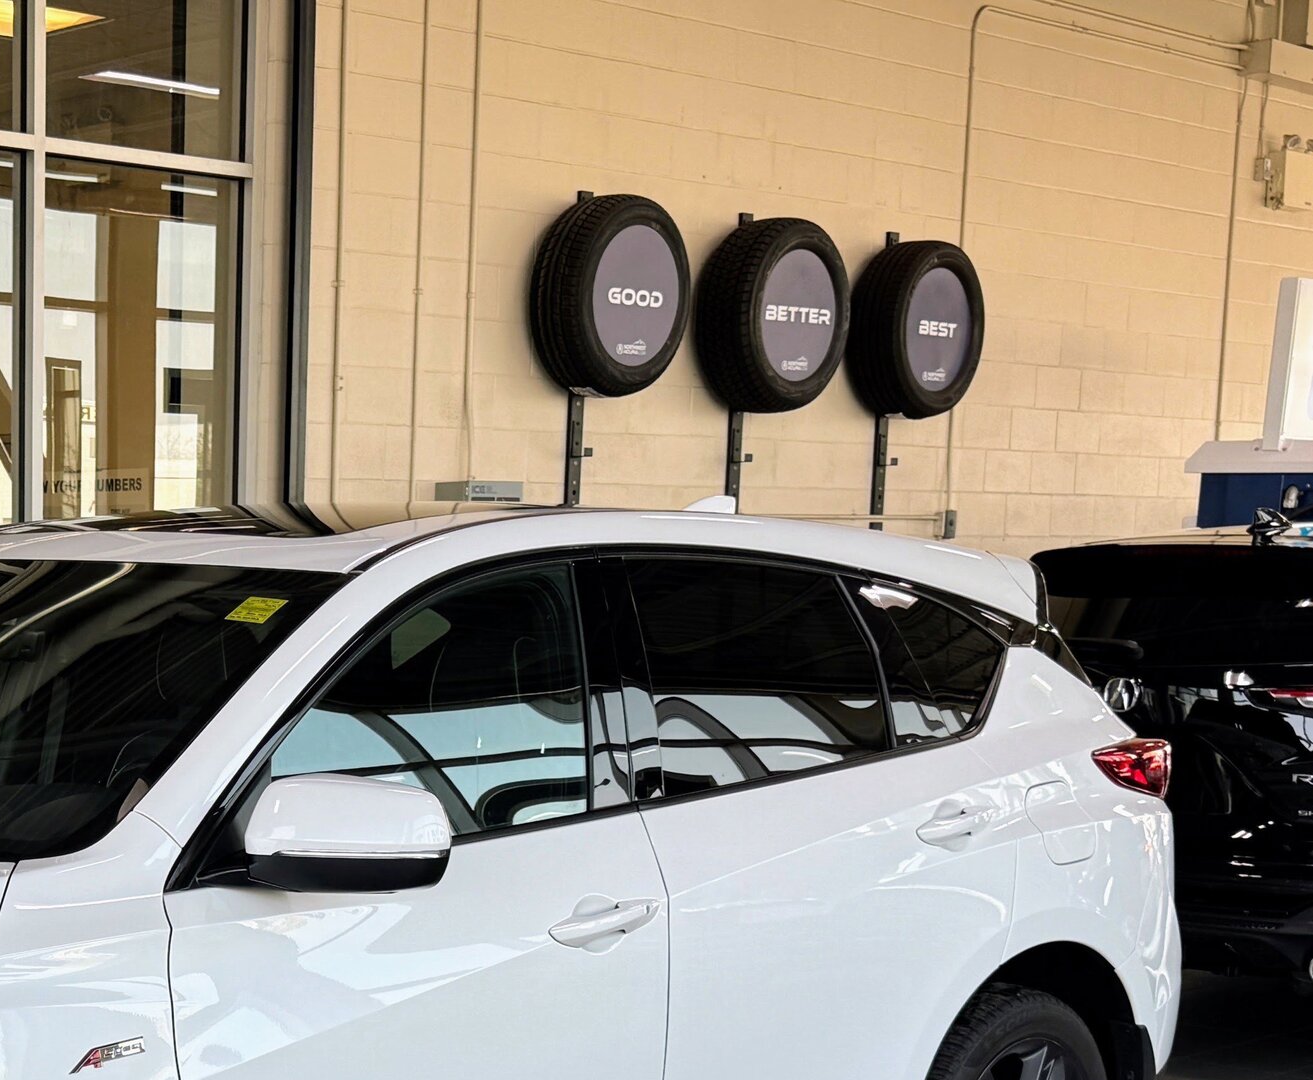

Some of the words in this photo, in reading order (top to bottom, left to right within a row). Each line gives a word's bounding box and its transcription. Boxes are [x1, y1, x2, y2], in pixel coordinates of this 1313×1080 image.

[608, 287, 663, 308] GOOD
[765, 305, 831, 325] BETTER
[918, 320, 957, 338] BEST
[88, 478, 142, 492] UMBERS
